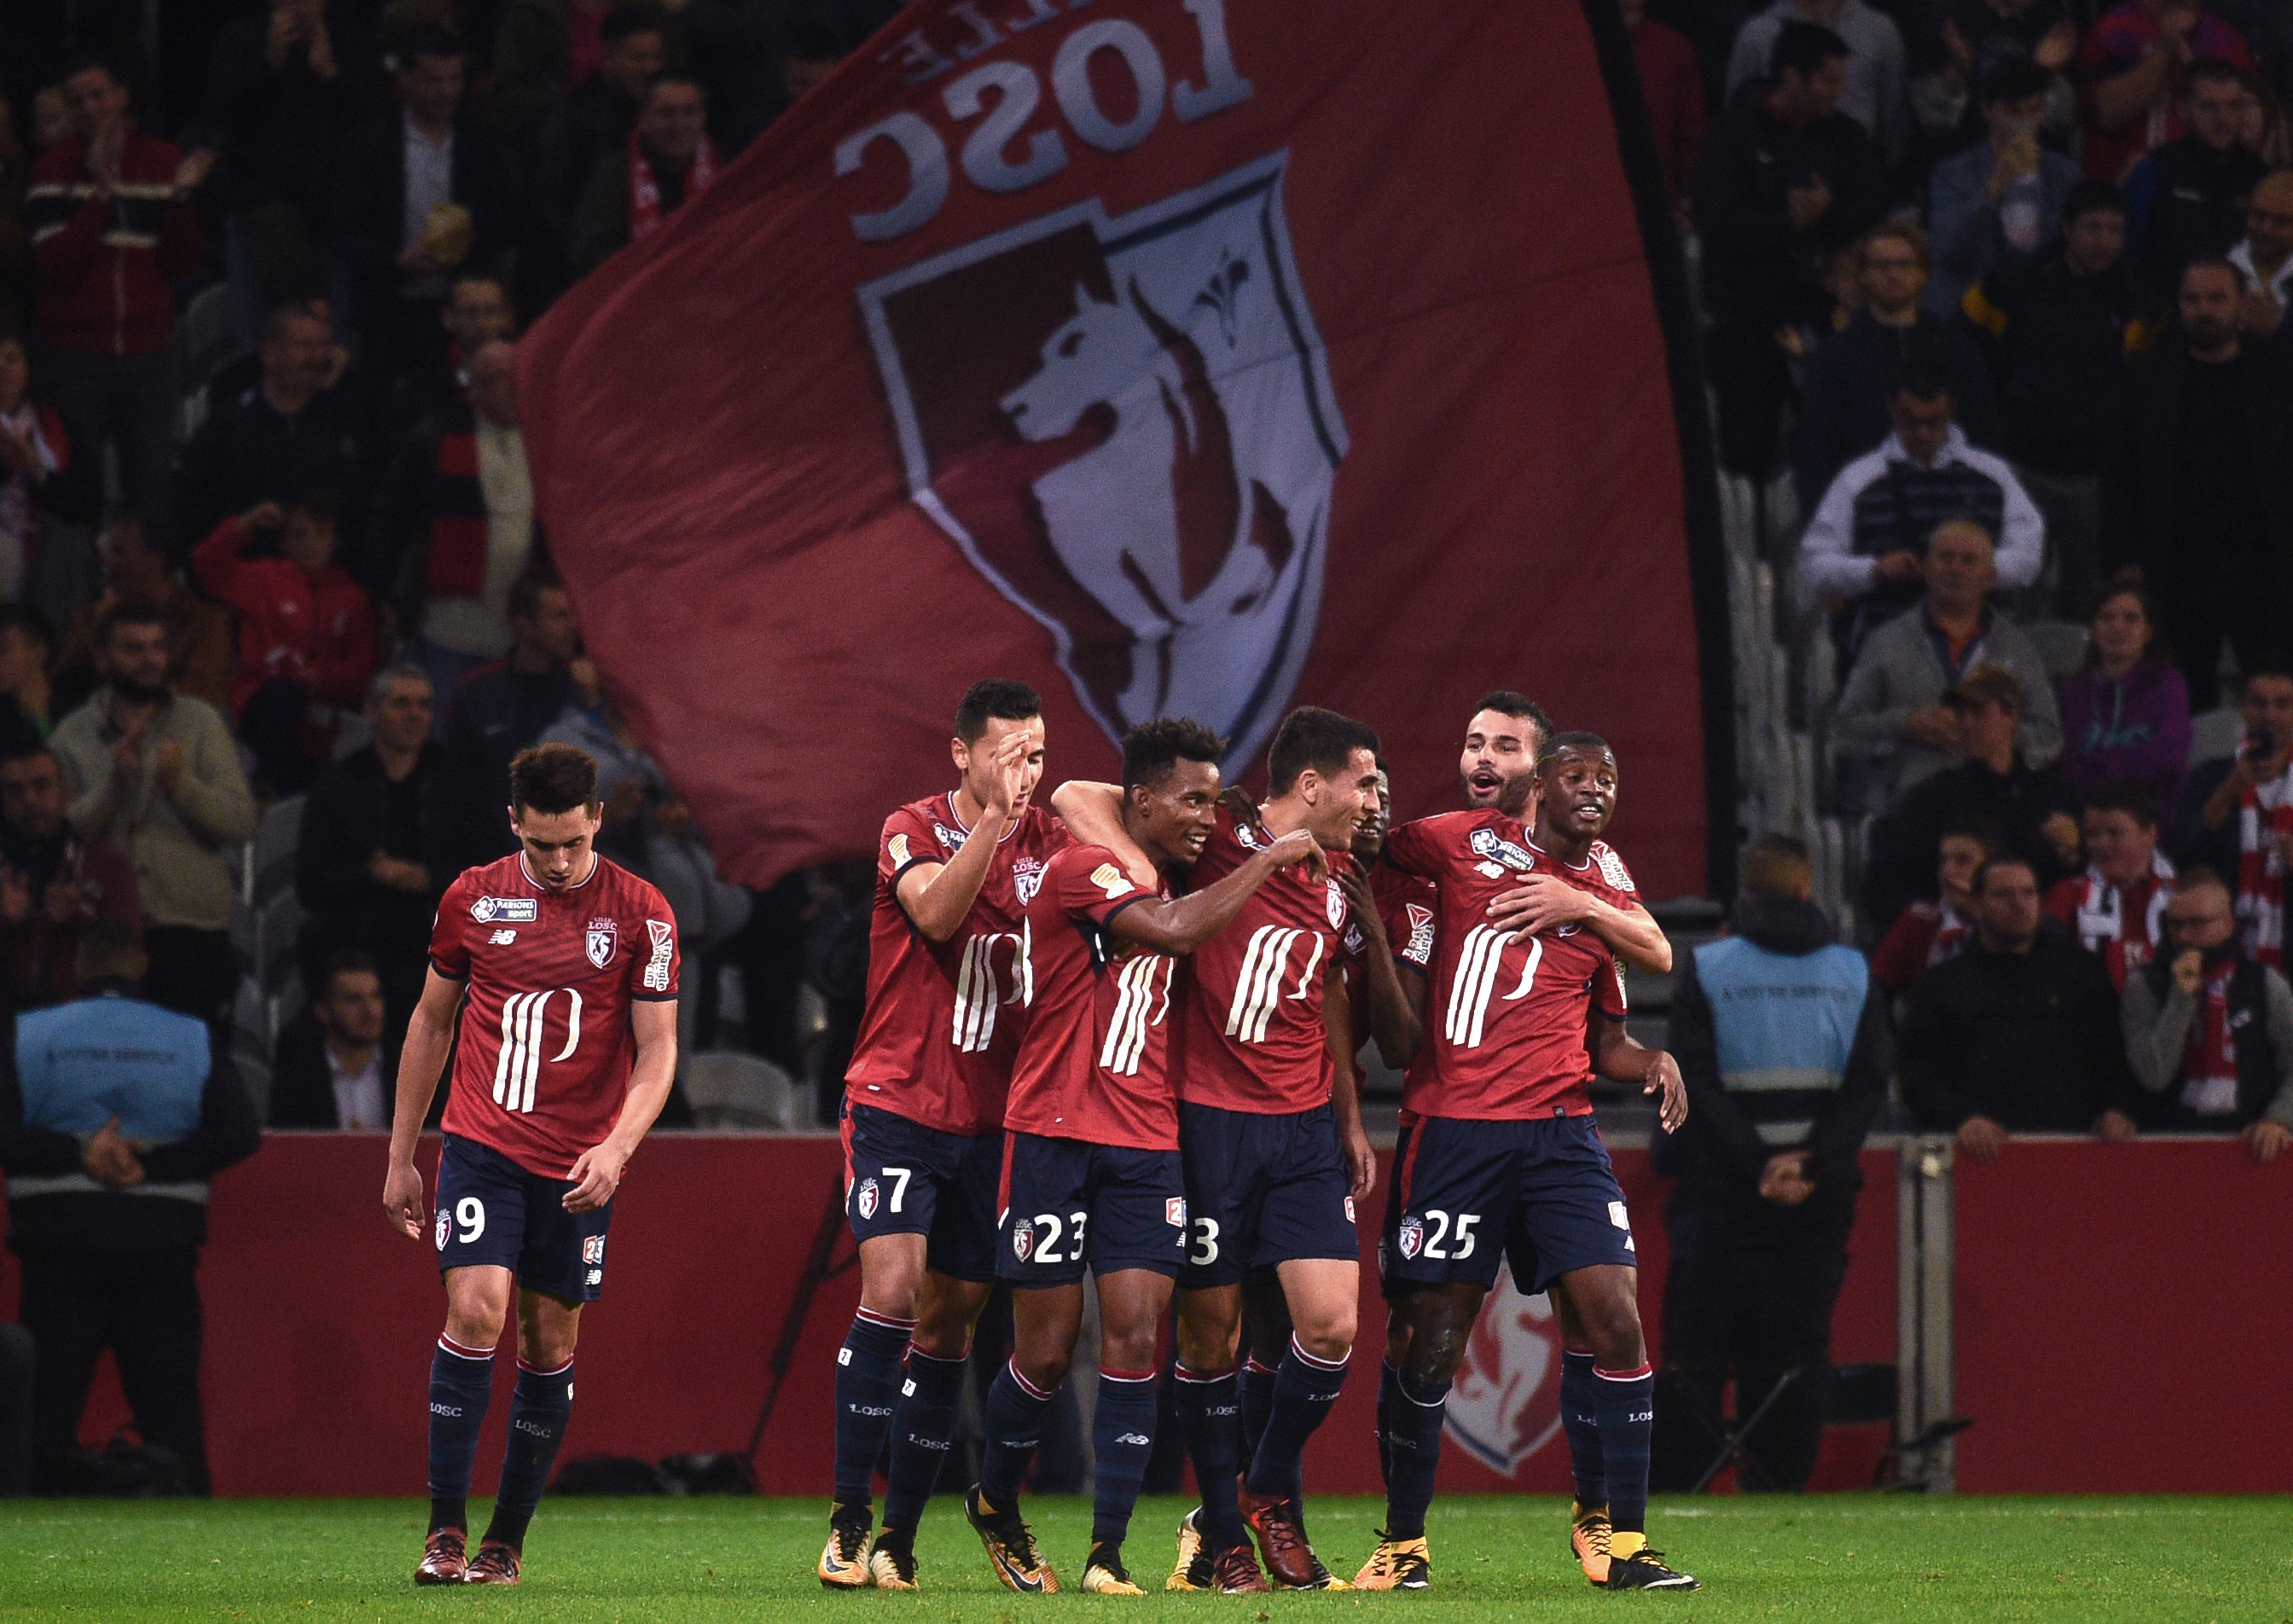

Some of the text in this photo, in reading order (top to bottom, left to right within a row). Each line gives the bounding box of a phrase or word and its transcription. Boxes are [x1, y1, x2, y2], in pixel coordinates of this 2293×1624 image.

[1013, 861, 1042, 873] LOSC
[496, 900, 535, 910] PARIONS
[508, 910, 533, 919] sport
[587, 921, 618, 931] LOSC
[658, 941, 671, 990] Triangle
[882, 1167, 912, 1213] 7
[456, 1197, 485, 1244] 9
[1034, 1211, 1088, 1263] 23
[1190, 1217, 1219, 1265] 3
[1423, 1209, 1482, 1259] 25
[430, 1401, 462, 1417] LOSC
[849, 1403, 893, 1417] LOSC
[1628, 1410, 1653, 1423] LOS
[515, 1419, 552, 1438] LOSC
[908, 1433, 951, 1451] LOSC
